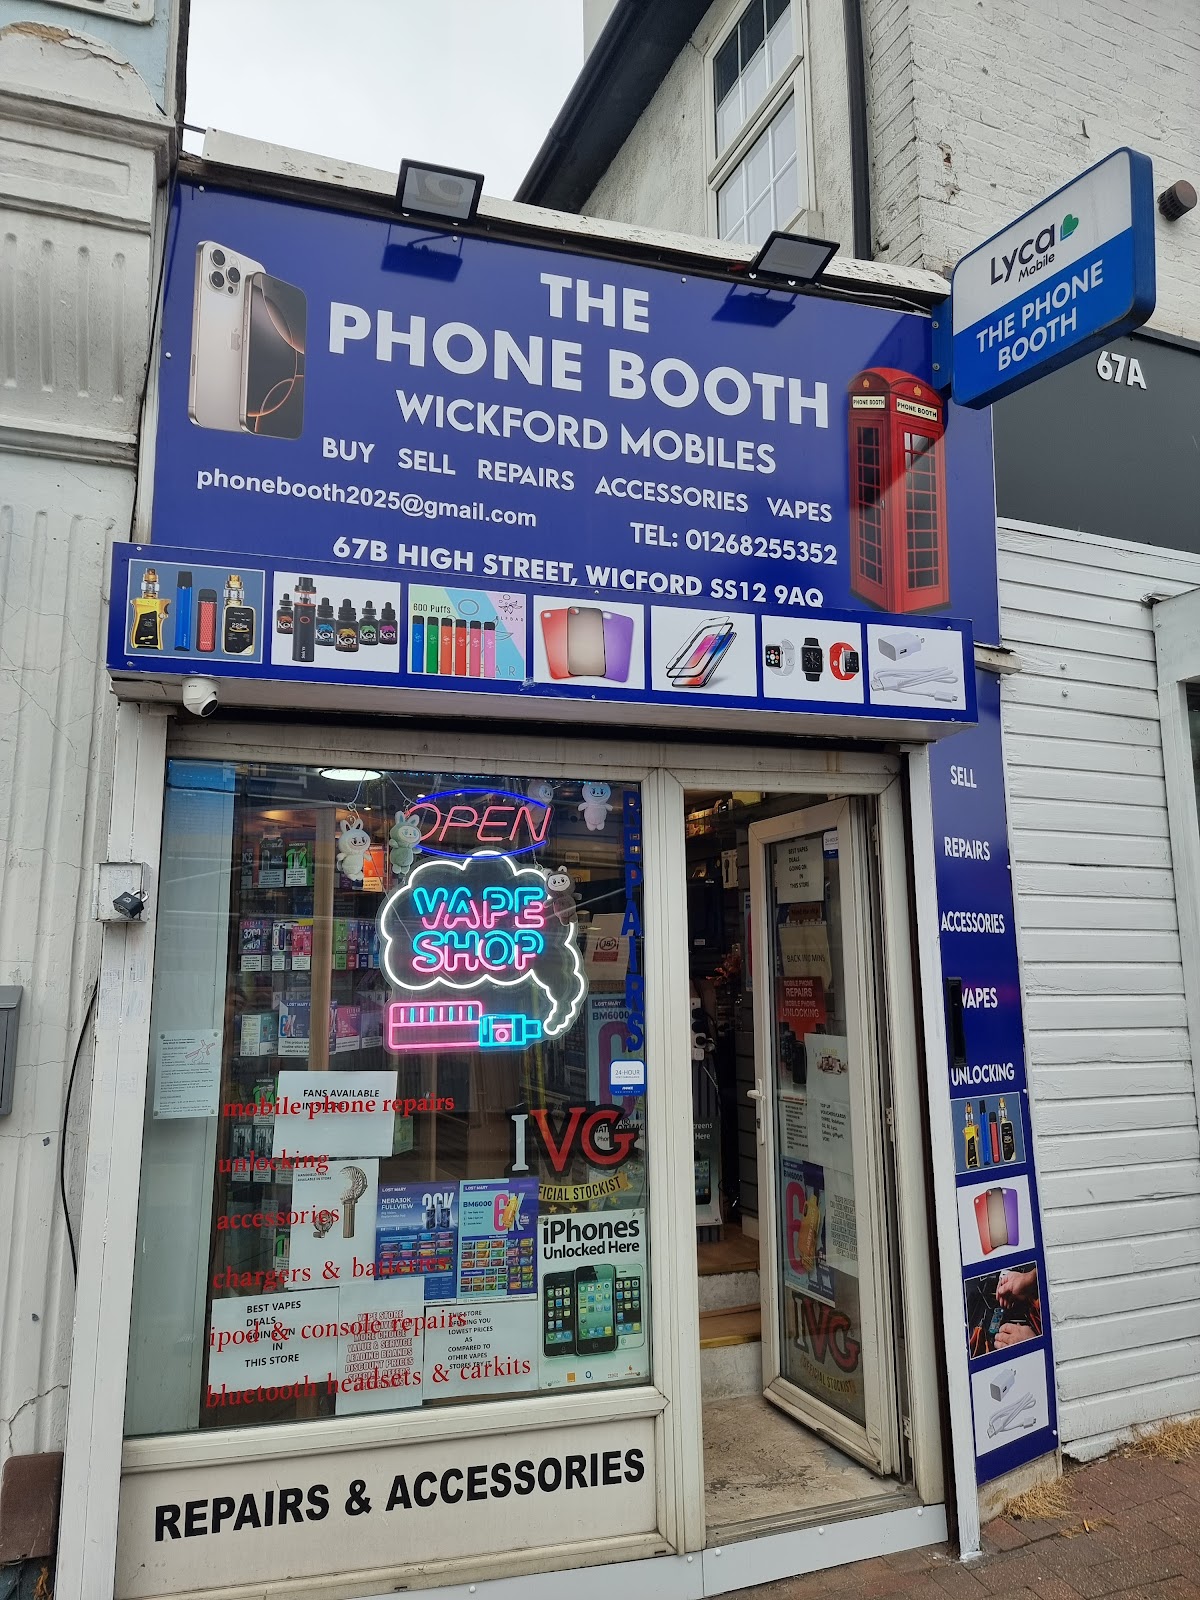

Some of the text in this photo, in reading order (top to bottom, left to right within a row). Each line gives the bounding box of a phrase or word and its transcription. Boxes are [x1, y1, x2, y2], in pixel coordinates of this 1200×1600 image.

[990, 223, 1055, 286] Lyca
[1018, 253, 1055, 283] Mobile
[540, 272, 650, 333] THE
[976, 259, 1104, 354] THE PHONE
[997, 307, 1078, 372] BOOTH
[328, 301, 829, 429] PHONE BOOTH
[1096, 350, 1148, 390] 67A
[897, 401, 937, 418] PHONE BOOTH
[396, 390, 776, 474] WICKFORD MOBILES
[322, 436, 833, 523] BUY SELL REPAIRS ACCESSORIES VAPES
[197, 468, 537, 527] phonebooth2025@gmail.com
[630, 522, 838, 566] TEL: 01268255352
[332, 536, 824, 609] 67B HIGH STREET, WICFORD SS12 9AQ
[413, 603, 451, 614] 600 Puffs
[315, 630, 334, 639] Koi
[336, 634, 357, 645] Koi
[359, 630, 377, 639] Koi
[379, 630, 396, 639] Koi
[950, 764, 977, 788] SELL
[404, 802, 551, 842] OPEN
[943, 836, 991, 861] REPAIRS
[413, 886, 546, 929] VAPE
[621, 790, 644, 1051] REPAIRS
[940, 911, 1005, 934] ACCESSORIES
[412, 929, 544, 973] SHOP
[785, 987, 813, 998] REPAIRS
[961, 987, 998, 1009] VAPES
[782, 1007, 820, 1018] UNLOCKING
[950, 1062, 1015, 1086] UNLOCKING
[303, 1088, 380, 1098] FANS AVAILABLE
[223, 1093, 455, 1120] mobile phone repairs
[693, 1122, 713, 1130] creens
[695, 1132, 711, 1140] Here
[511, 1106, 635, 1173] IVG
[219, 1149, 330, 1174] unlocking
[573, 1176, 621, 1200] STOCKIST
[216, 1205, 340, 1231] accessories
[543, 1218, 640, 1246] iPhones
[543, 1240, 640, 1260] Unlocked Here
[212, 1256, 448, 1291] chargers & batteries
[246, 1300, 302, 1314] BEST VAPES
[378, 1310, 404, 1320] STORE
[209, 1319, 260, 1351] ipod
[271, 1320, 290, 1342] &
[301, 1313, 382, 1341] console
[393, 1310, 467, 1338] repairs
[246, 1316, 277, 1327] DEALS
[473, 1325, 493, 1334] PRICES
[272, 1342, 283, 1352] IN
[347, 1338, 413, 1353] VALUE & SERVICE
[354, 1330, 407, 1342] MORE CHOICE
[447, 1344, 481, 1352] COMPARED
[245, 1353, 300, 1368] THIS STORE
[345, 1357, 414, 1373] DISCOUNT PRICES
[346, 1348, 413, 1362] LEADING BRANDS
[205, 1376, 318, 1408] bluetooth
[327, 1366, 422, 1395] headsets
[432, 1363, 450, 1383] &
[460, 1355, 532, 1381] carkits
[154, 1448, 645, 1542] REPAIRS & ACCESSORIES
